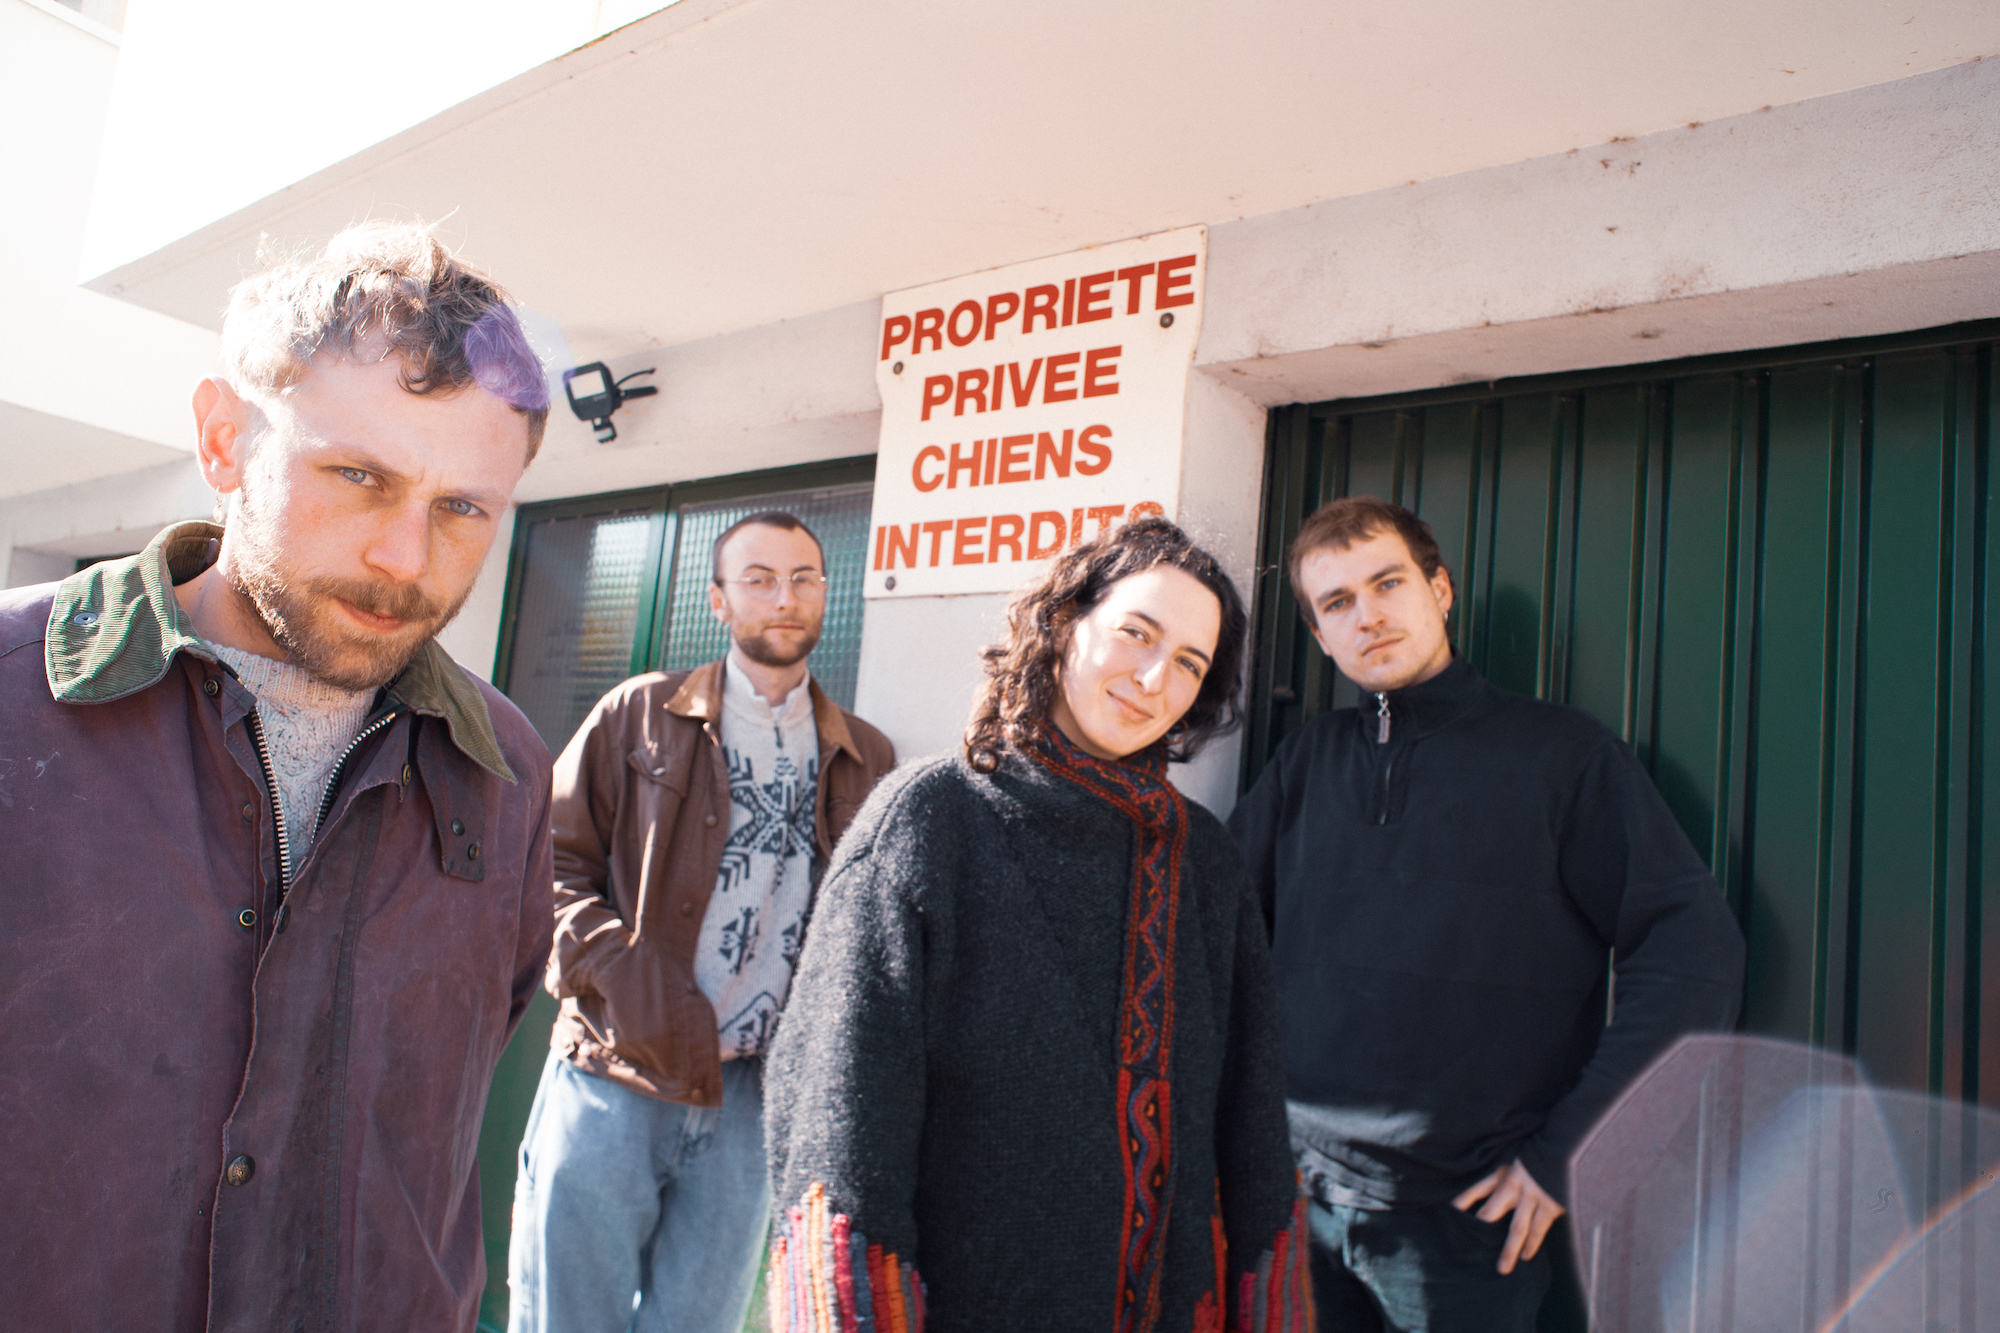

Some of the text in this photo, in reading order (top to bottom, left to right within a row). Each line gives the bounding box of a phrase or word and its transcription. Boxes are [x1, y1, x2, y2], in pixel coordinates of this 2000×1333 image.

[880, 253, 1198, 361] PROPRIETE
[920, 344, 1123, 422] PRIVEE
[911, 424, 1113, 493] CHIENS
